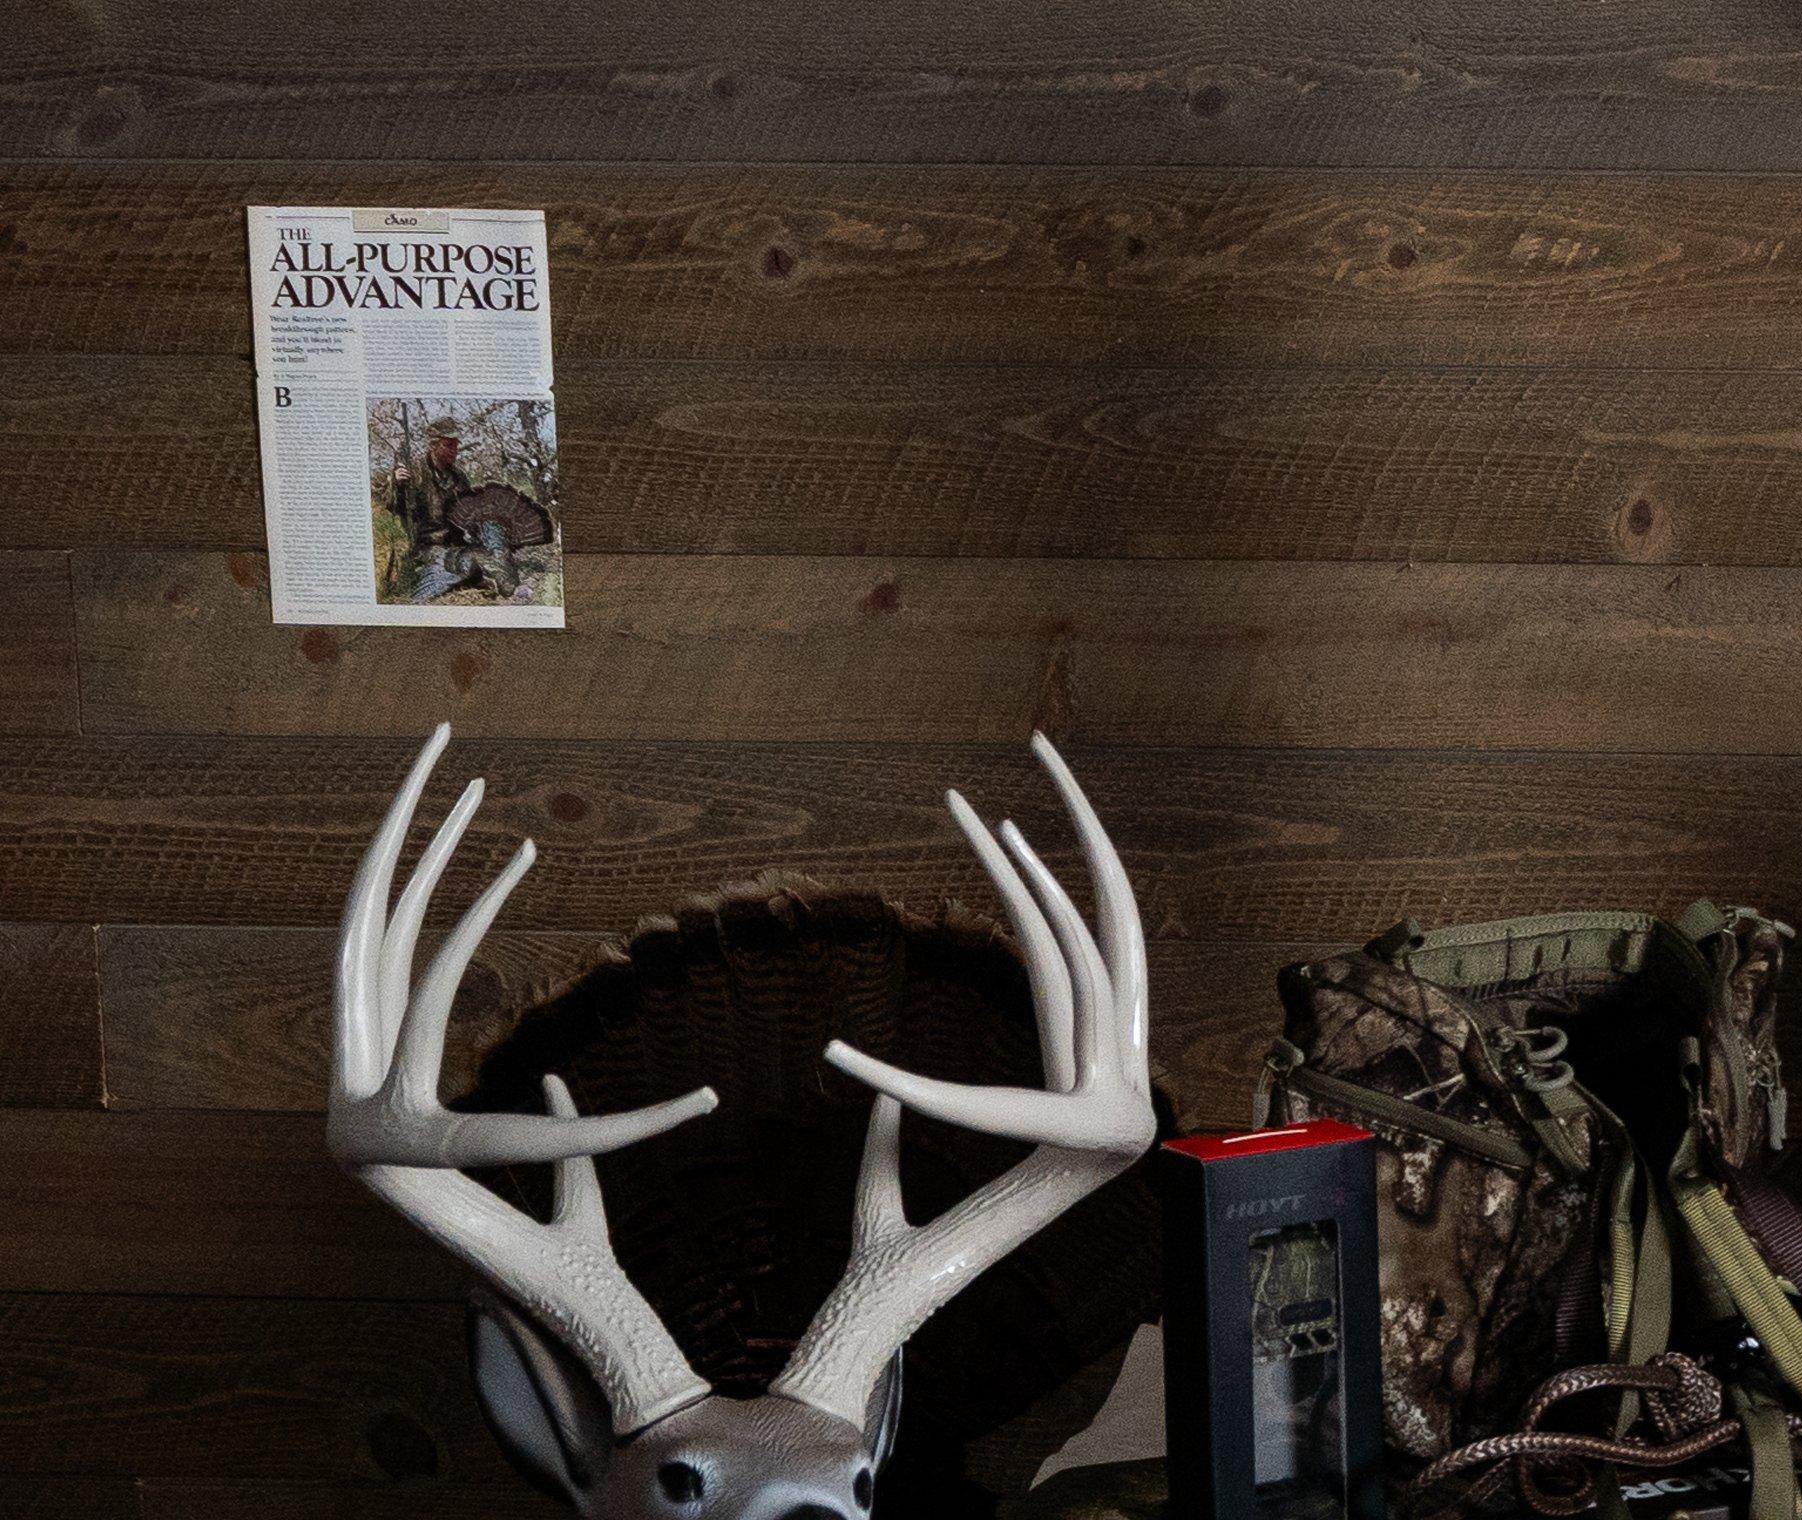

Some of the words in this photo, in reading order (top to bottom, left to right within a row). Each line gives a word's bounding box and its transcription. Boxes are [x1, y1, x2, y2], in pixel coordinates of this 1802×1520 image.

[277, 227, 312, 241] THE
[269, 241, 538, 276] ALL-PURPOSE
[270, 275, 541, 312] ADVANTAGE
[274, 386, 293, 408] B
